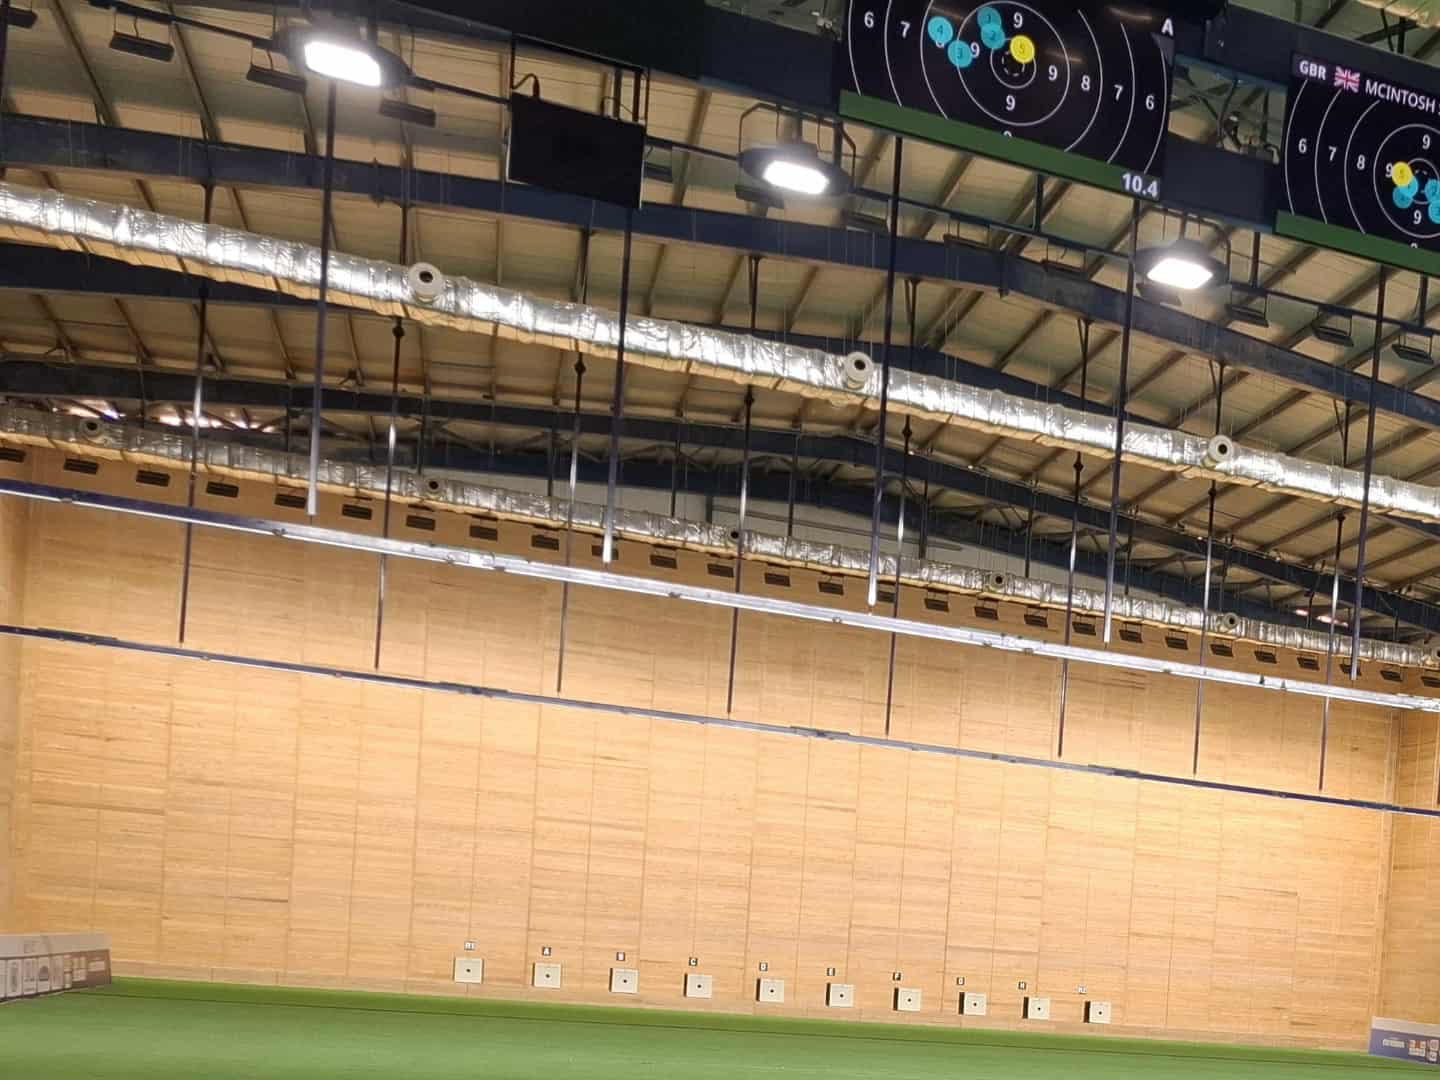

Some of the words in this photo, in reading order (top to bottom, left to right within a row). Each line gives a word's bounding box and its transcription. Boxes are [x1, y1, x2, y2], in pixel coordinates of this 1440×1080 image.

[1013, 12, 1023, 28] 9
[1161, 18, 1174, 35] A
[864, 12, 874, 27] 6
[901, 22, 911, 38] 7
[970, 42, 980, 58] 9
[1048, 65, 1058, 80] 9
[1080, 75, 1090, 92] 8
[1114, 85, 1123, 100] 7
[1145, 95, 1155, 110] 6
[1299, 60, 1327, 81] GBR
[1365, 79, 1436, 113] MCINTOSH
[1005, 95, 1016, 111] 9
[1422, 135, 1431, 150] 9
[1298, 139, 1307, 153] 6
[1328, 147, 1337, 161] 7
[1356, 155, 1365, 170] 8
[1122, 172, 1159, 198] 10.4
[1413, 209, 1422, 225] 9
